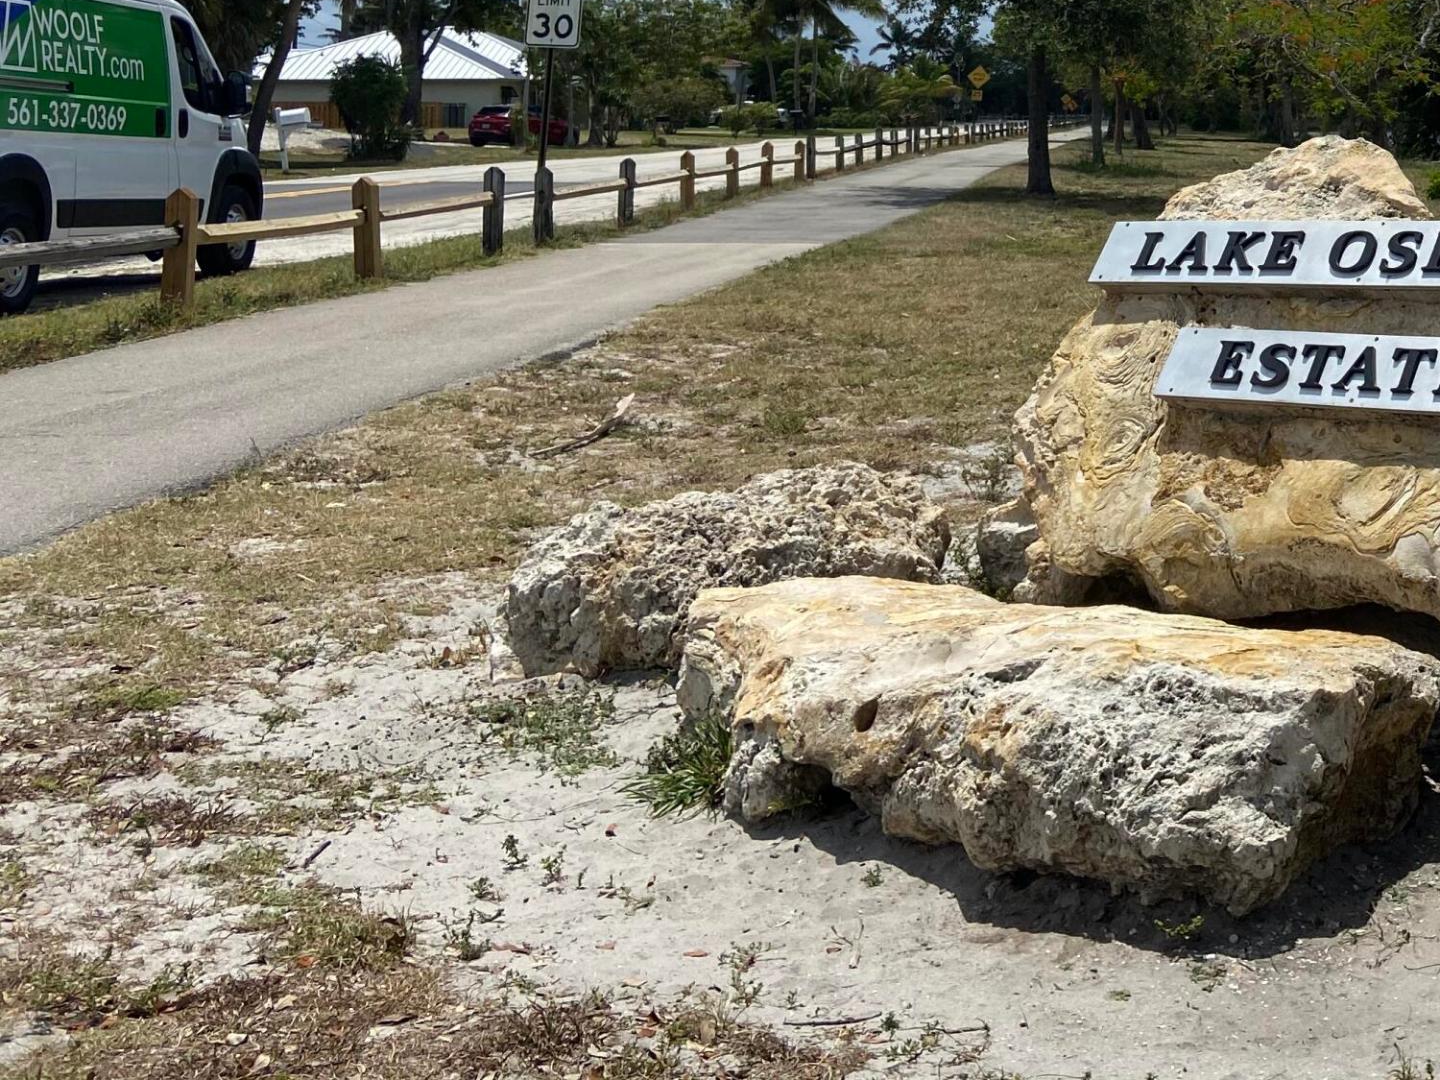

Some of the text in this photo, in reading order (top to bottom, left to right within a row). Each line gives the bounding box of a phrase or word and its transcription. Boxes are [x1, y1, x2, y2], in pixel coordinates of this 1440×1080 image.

[32, 5, 104, 44] WOOLF
[532, 13, 573, 38] 30
[41, 39, 145, 81] REALTY.com
[7, 97, 127, 130] 561-337-0369
[1130, 230, 1306, 273] LAKE
